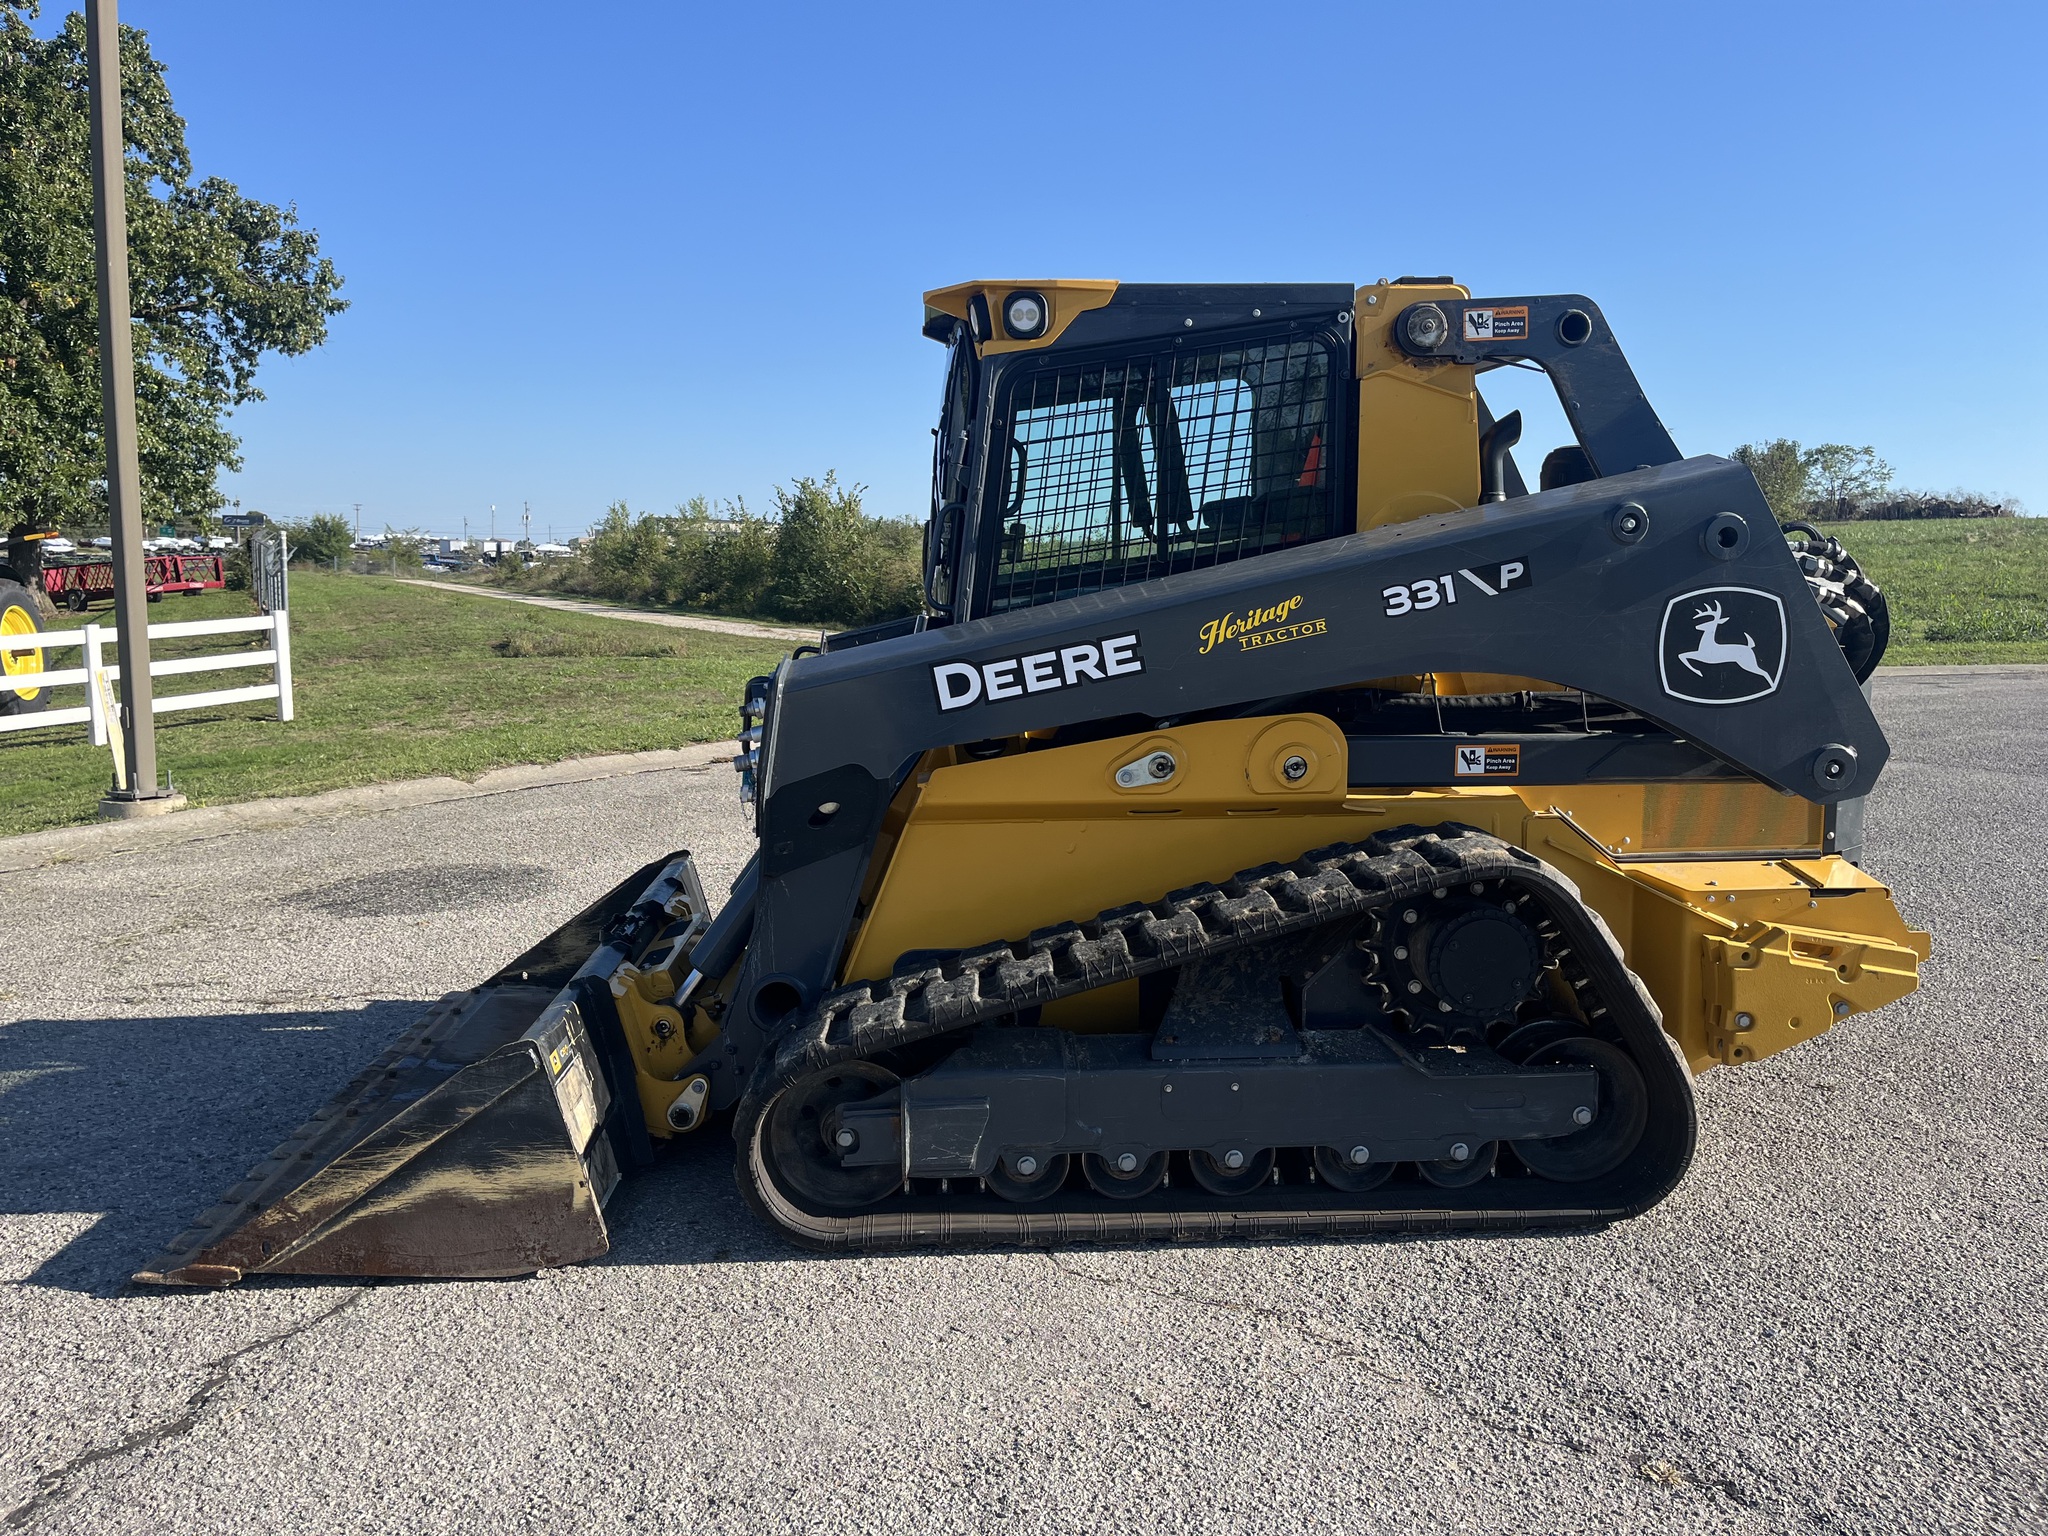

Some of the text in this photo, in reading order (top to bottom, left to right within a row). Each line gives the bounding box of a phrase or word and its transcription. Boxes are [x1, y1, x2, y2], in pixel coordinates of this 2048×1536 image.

[1198, 594, 1304, 655] Heritage
[1238, 621, 1327, 649] TRACTOR
[933, 634, 1142, 711] DEERE
